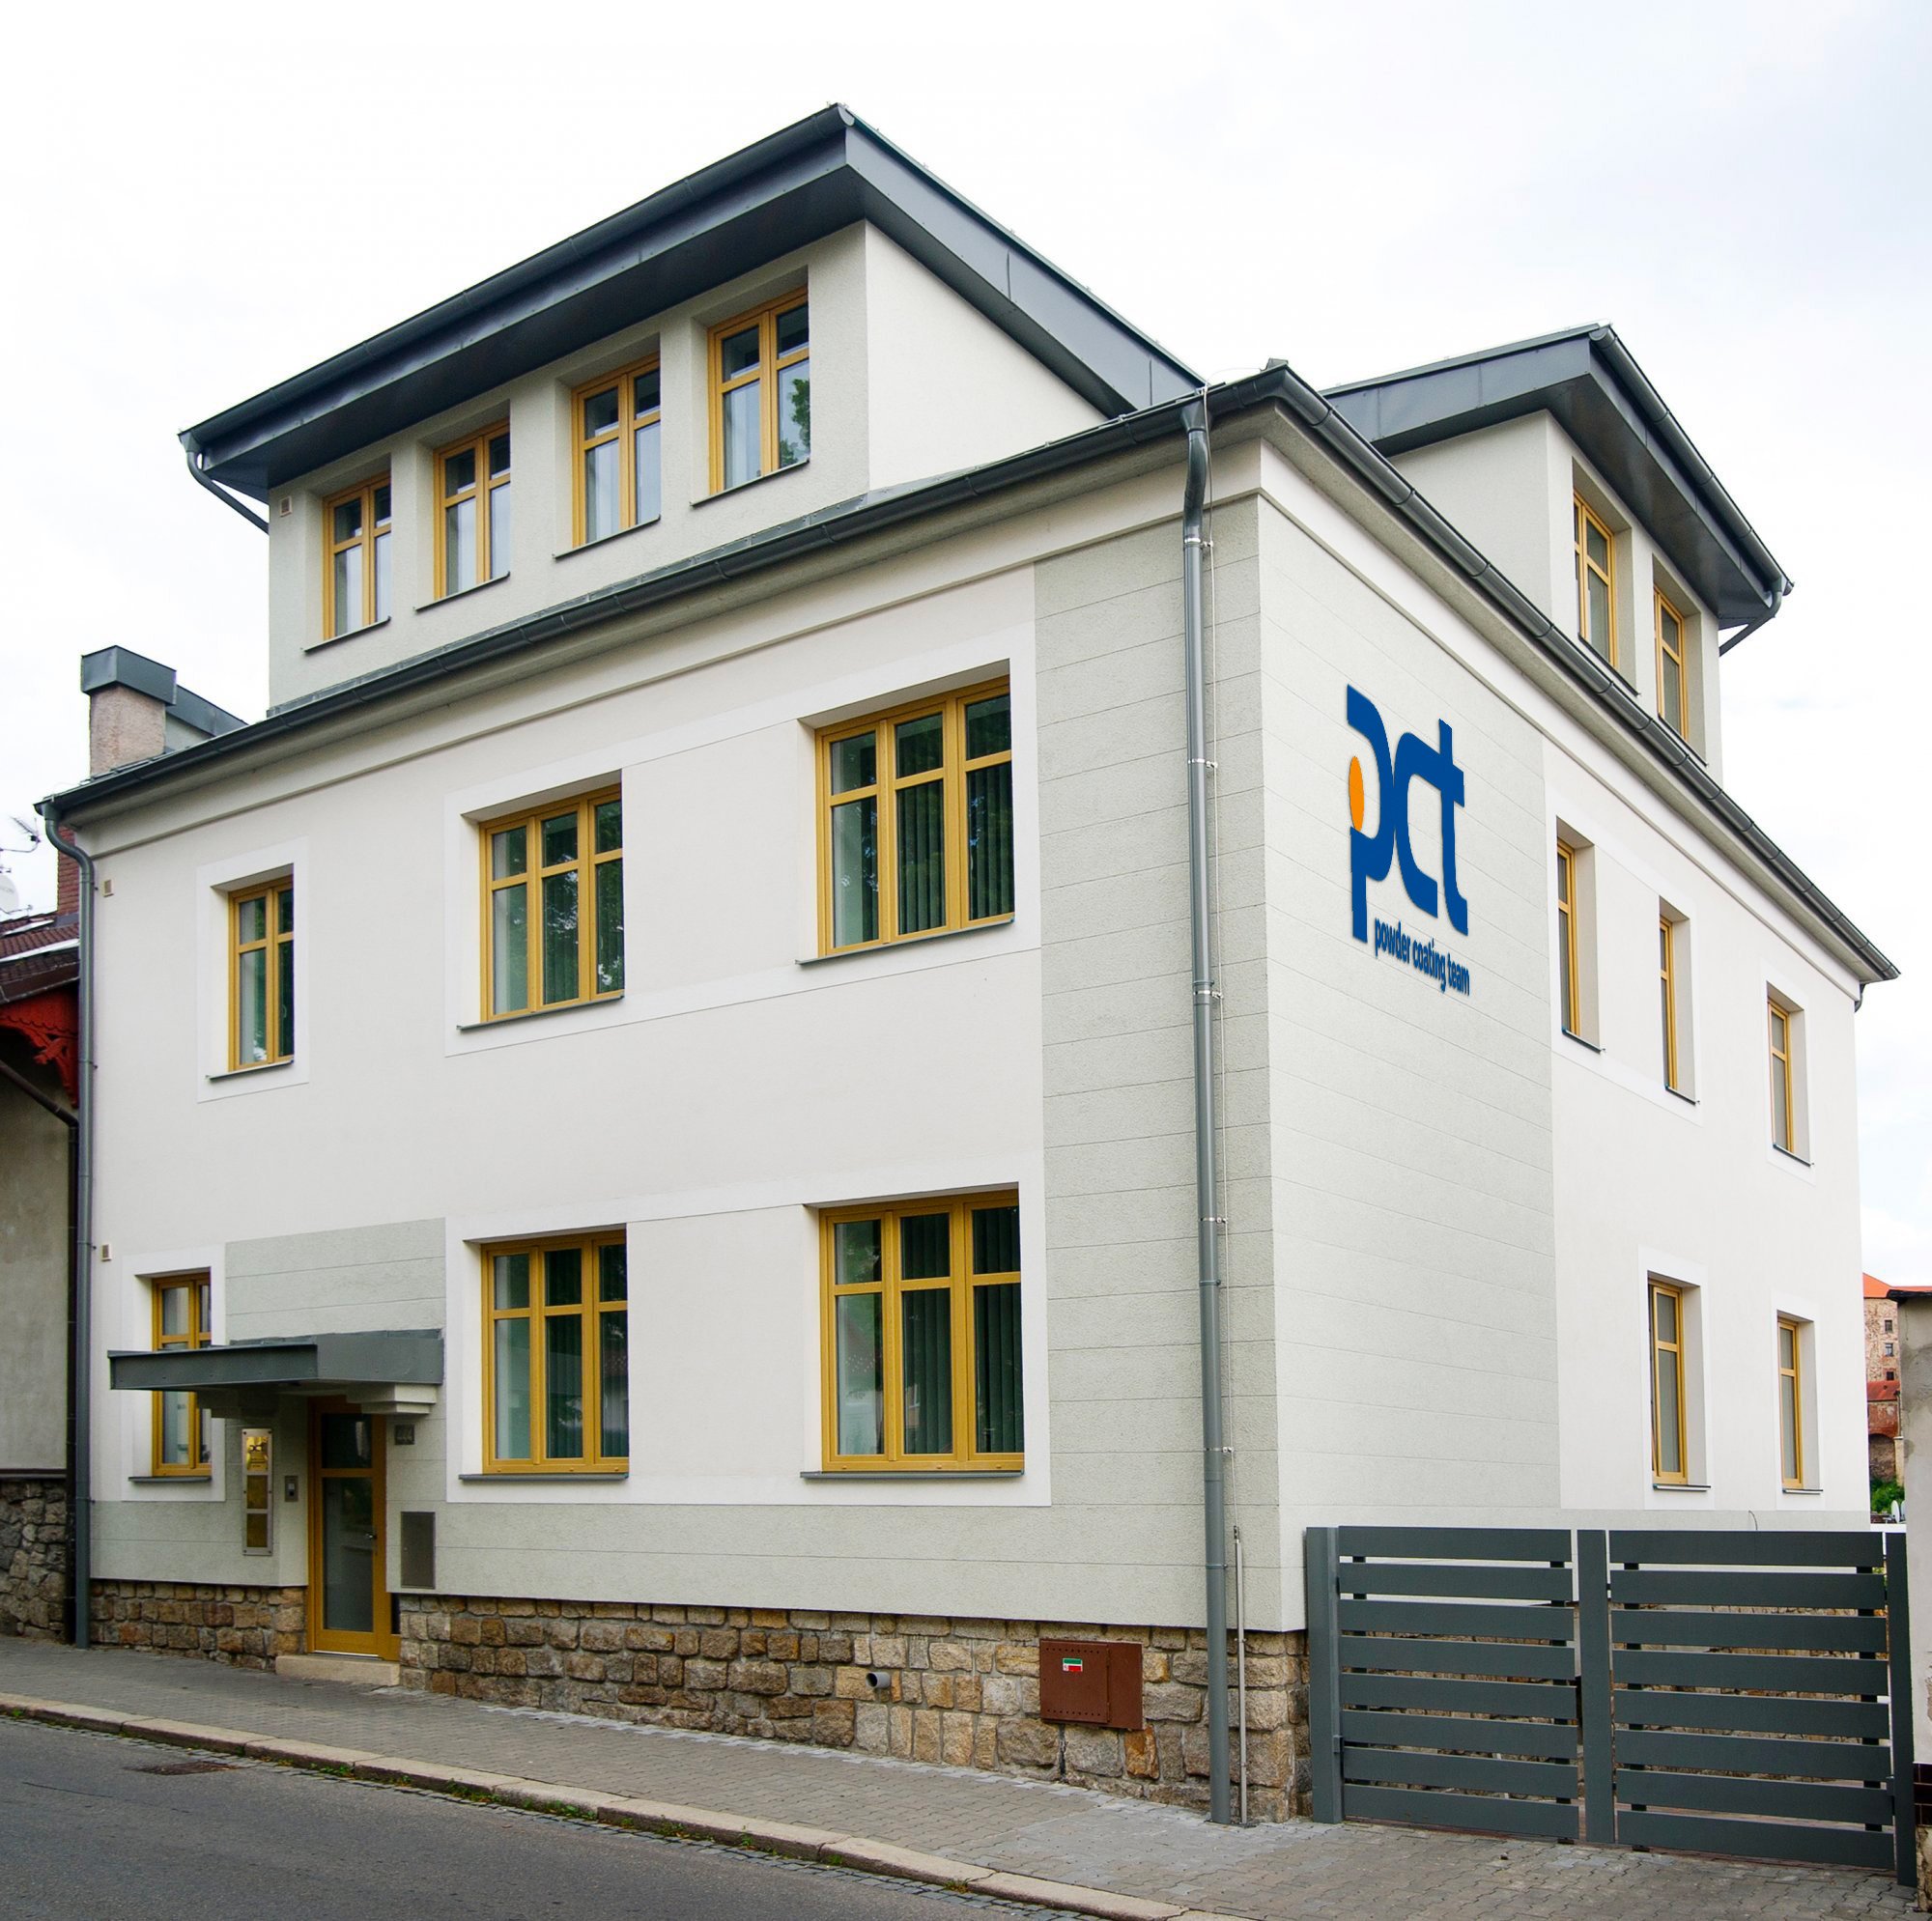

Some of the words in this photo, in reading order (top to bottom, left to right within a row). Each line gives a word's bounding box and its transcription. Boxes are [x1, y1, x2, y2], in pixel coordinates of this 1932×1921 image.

[1347, 684, 1468, 943] pct
[1375, 918, 1411, 964] powder
[1412, 938, 1447, 993] coating
[1447, 953, 1470, 996] team
